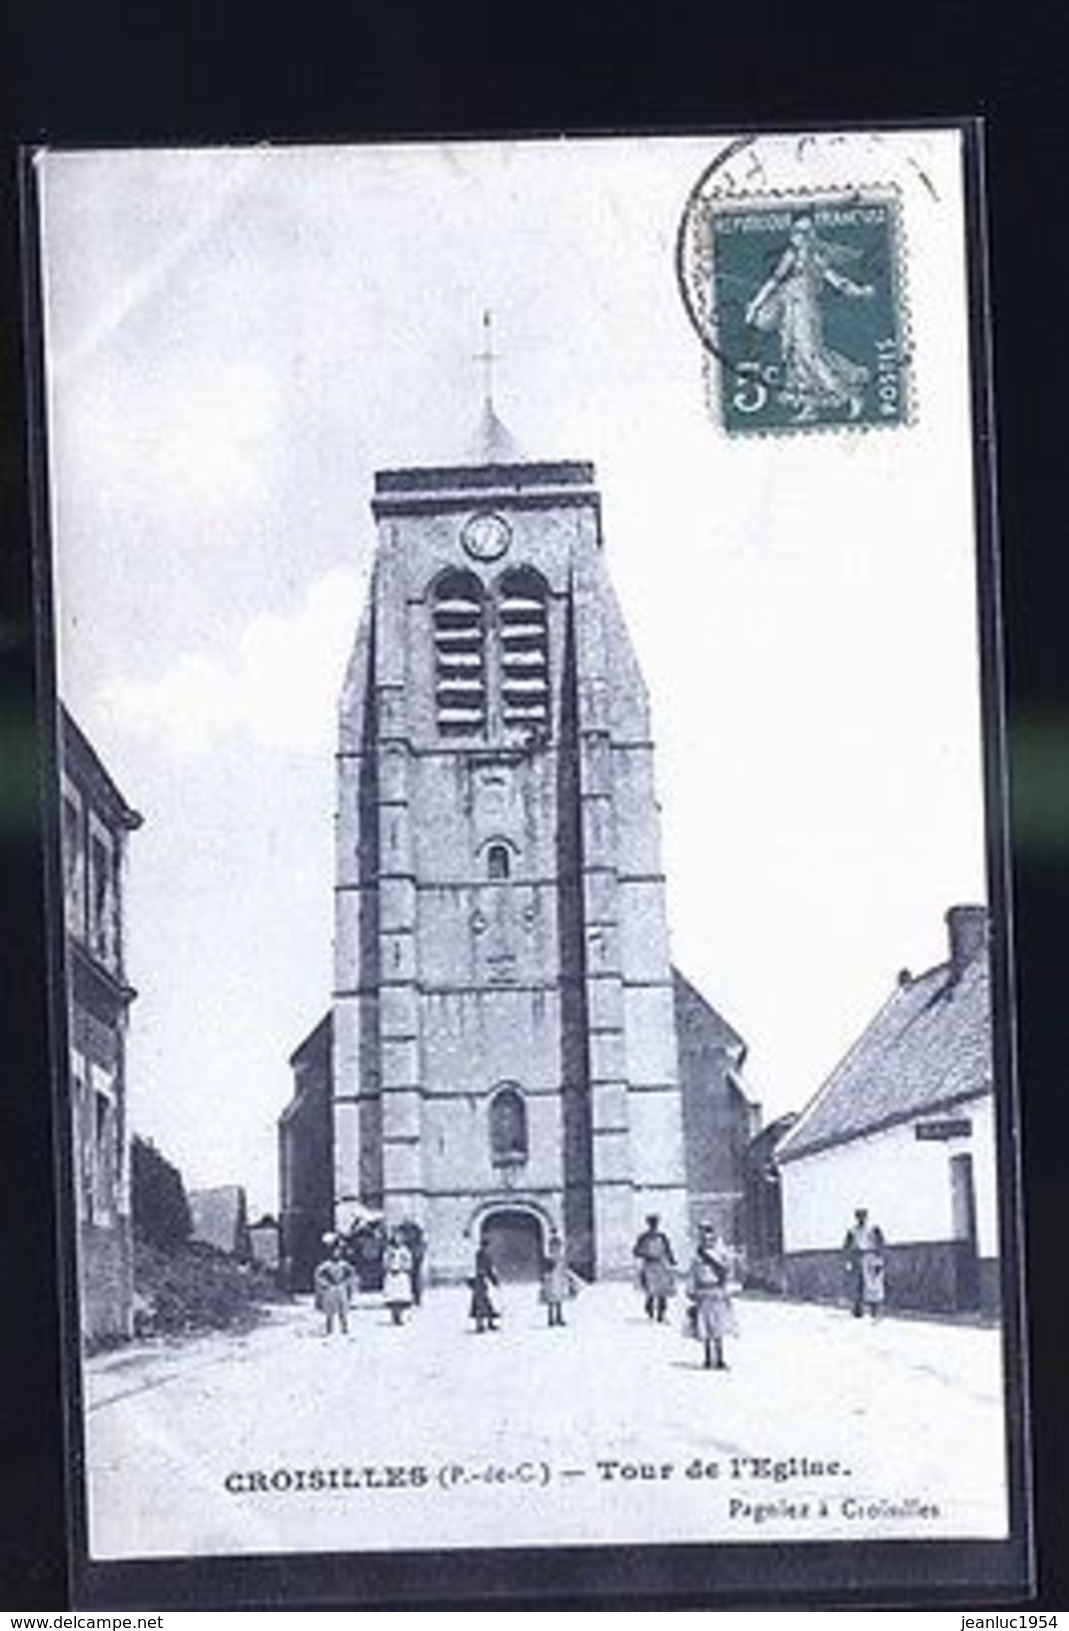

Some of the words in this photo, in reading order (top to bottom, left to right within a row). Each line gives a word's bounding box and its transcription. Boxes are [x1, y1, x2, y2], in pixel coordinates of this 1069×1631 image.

[224, 1466, 429, 1493] CROISILLES
[596, 1460, 675, 1481] Tour
[684, 1458, 719, 1480] de
